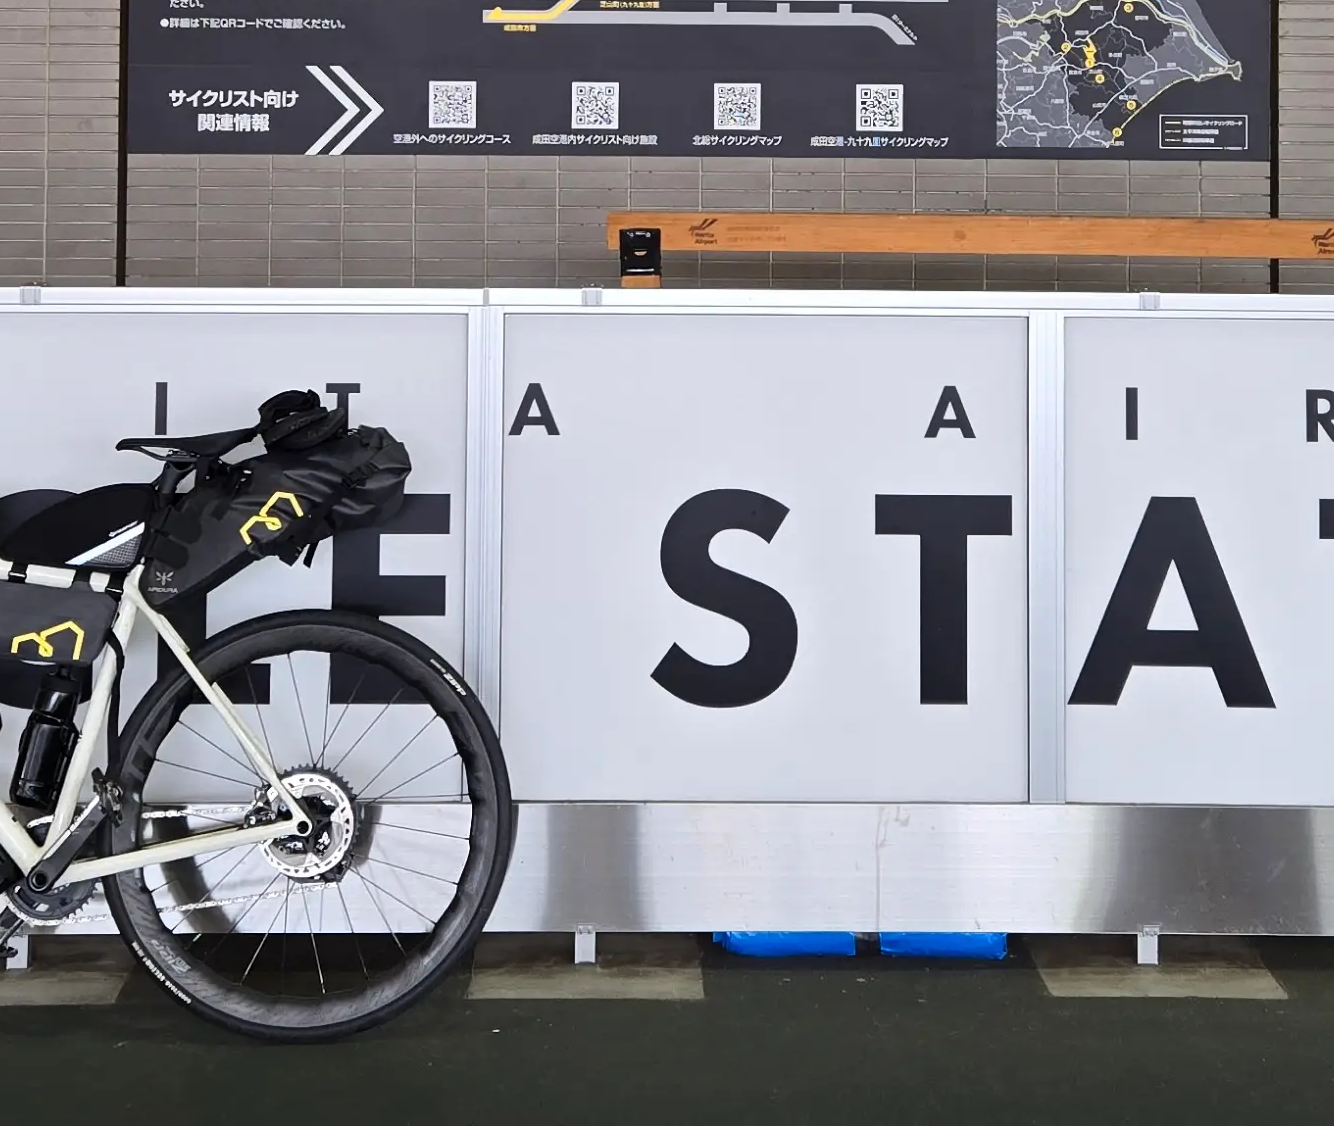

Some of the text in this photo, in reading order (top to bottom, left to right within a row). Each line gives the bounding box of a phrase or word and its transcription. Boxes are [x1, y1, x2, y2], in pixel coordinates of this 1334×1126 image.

[169, 90, 299, 108] サイクリスト向け
[198, 114, 269, 131] 関連情報
[394, 134, 511, 144] 空港外へのサイクリングコース
